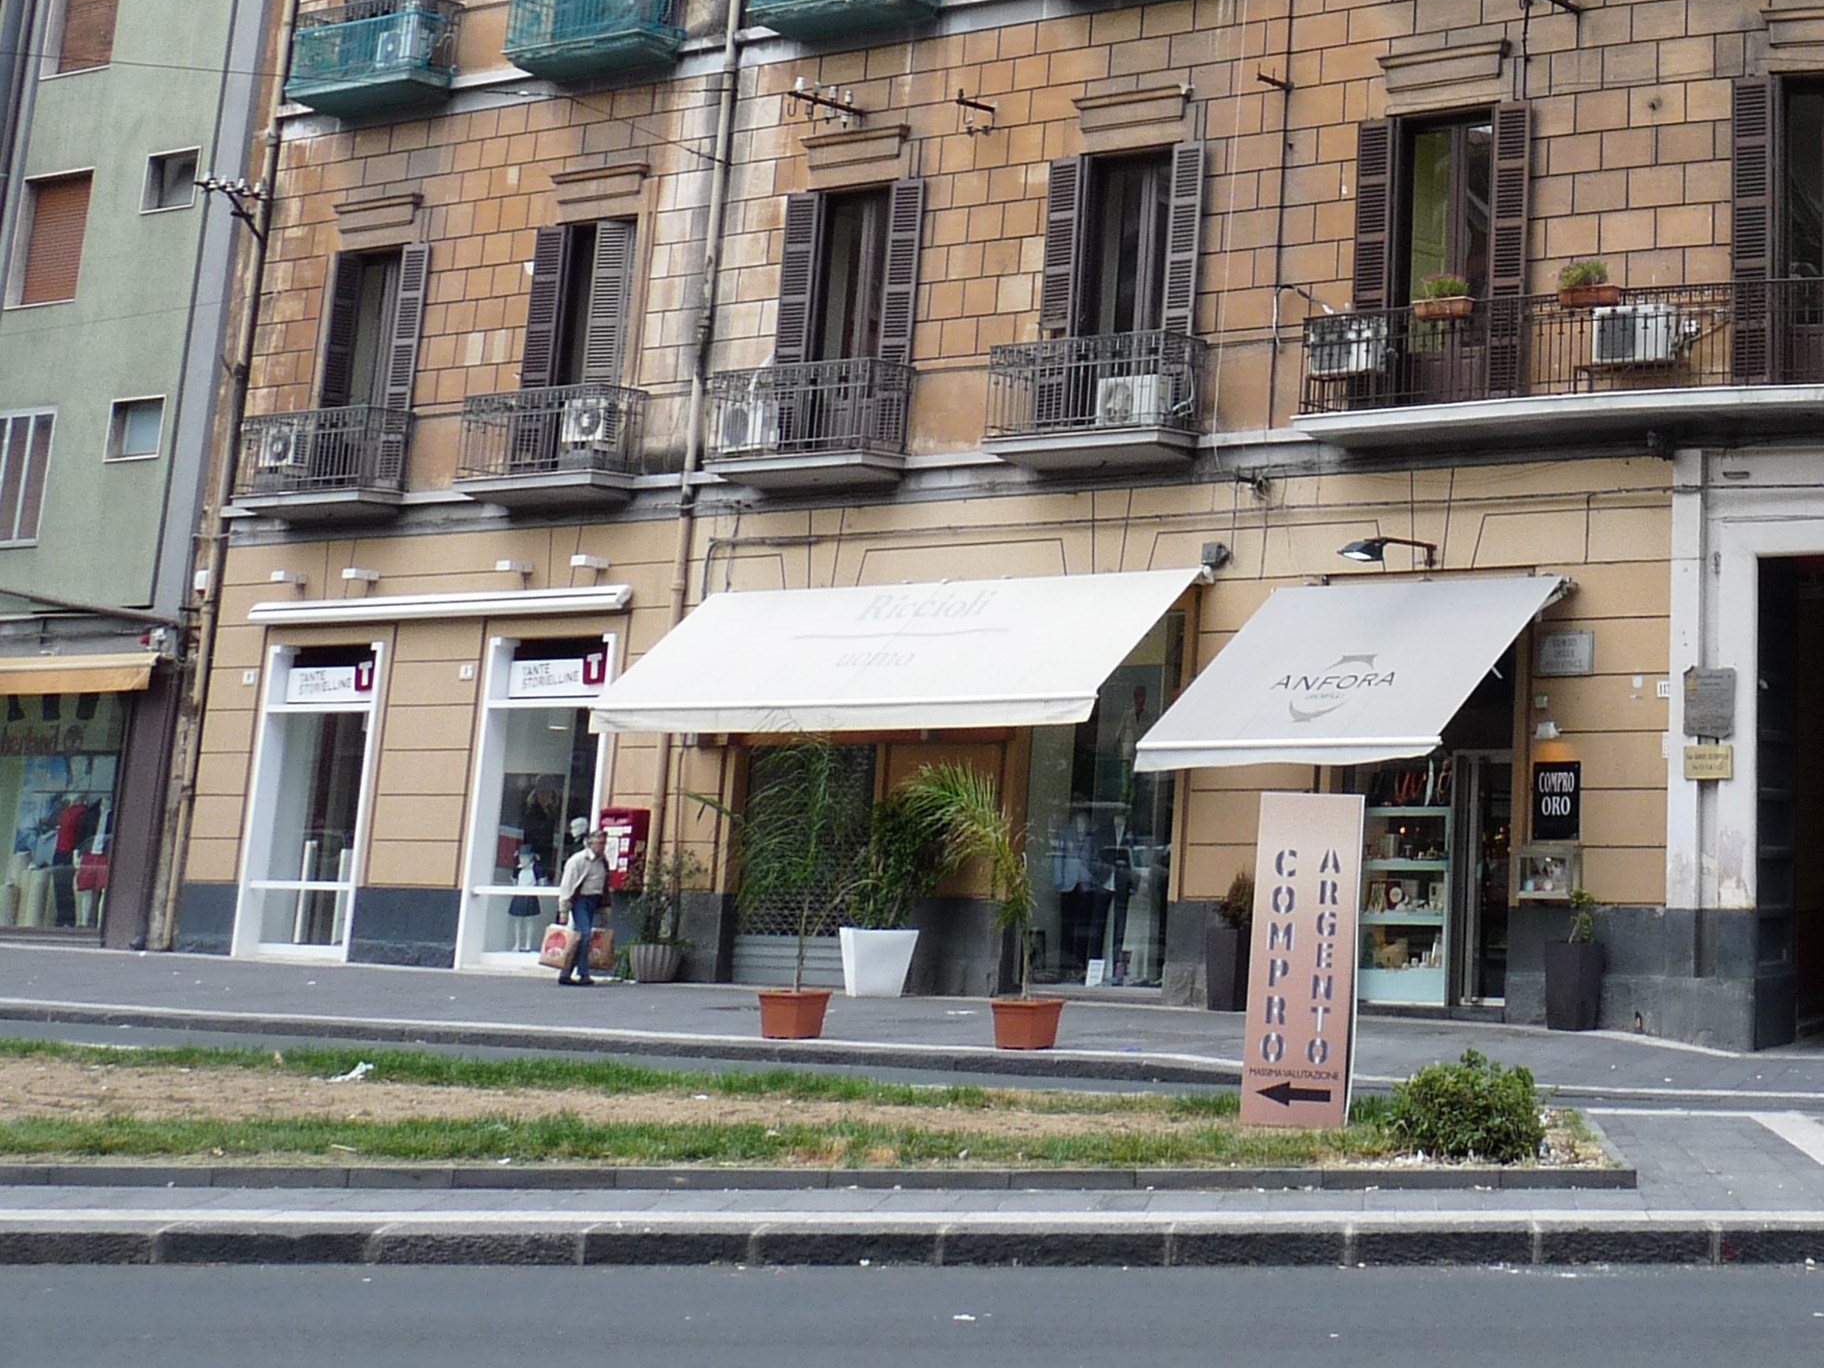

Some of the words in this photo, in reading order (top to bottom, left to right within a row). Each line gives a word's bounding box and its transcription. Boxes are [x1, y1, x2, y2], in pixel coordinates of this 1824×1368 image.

[854, 589, 998, 622] Riccioli
[587, 653, 603, 680] T
[835, 650, 916, 668] uomo
[298, 669, 327, 682] TANTE
[359, 660, 373, 687] T
[521, 670, 580, 690] STORIELLINE
[522, 663, 551, 677] TANTE
[298, 677, 353, 695] STORIELLINE
[1269, 671, 1396, 691] ANFORA
[1538, 771, 1575, 793] COMPRO
[1541, 796, 1571, 816] ORO
[1259, 848, 1298, 1063] COMPRO
[1306, 848, 1341, 1065] ARGENTO
[1249, 1066, 1281, 1078] MASSIMA
[1282, 1068, 1340, 1080] VALUTAZIONE
